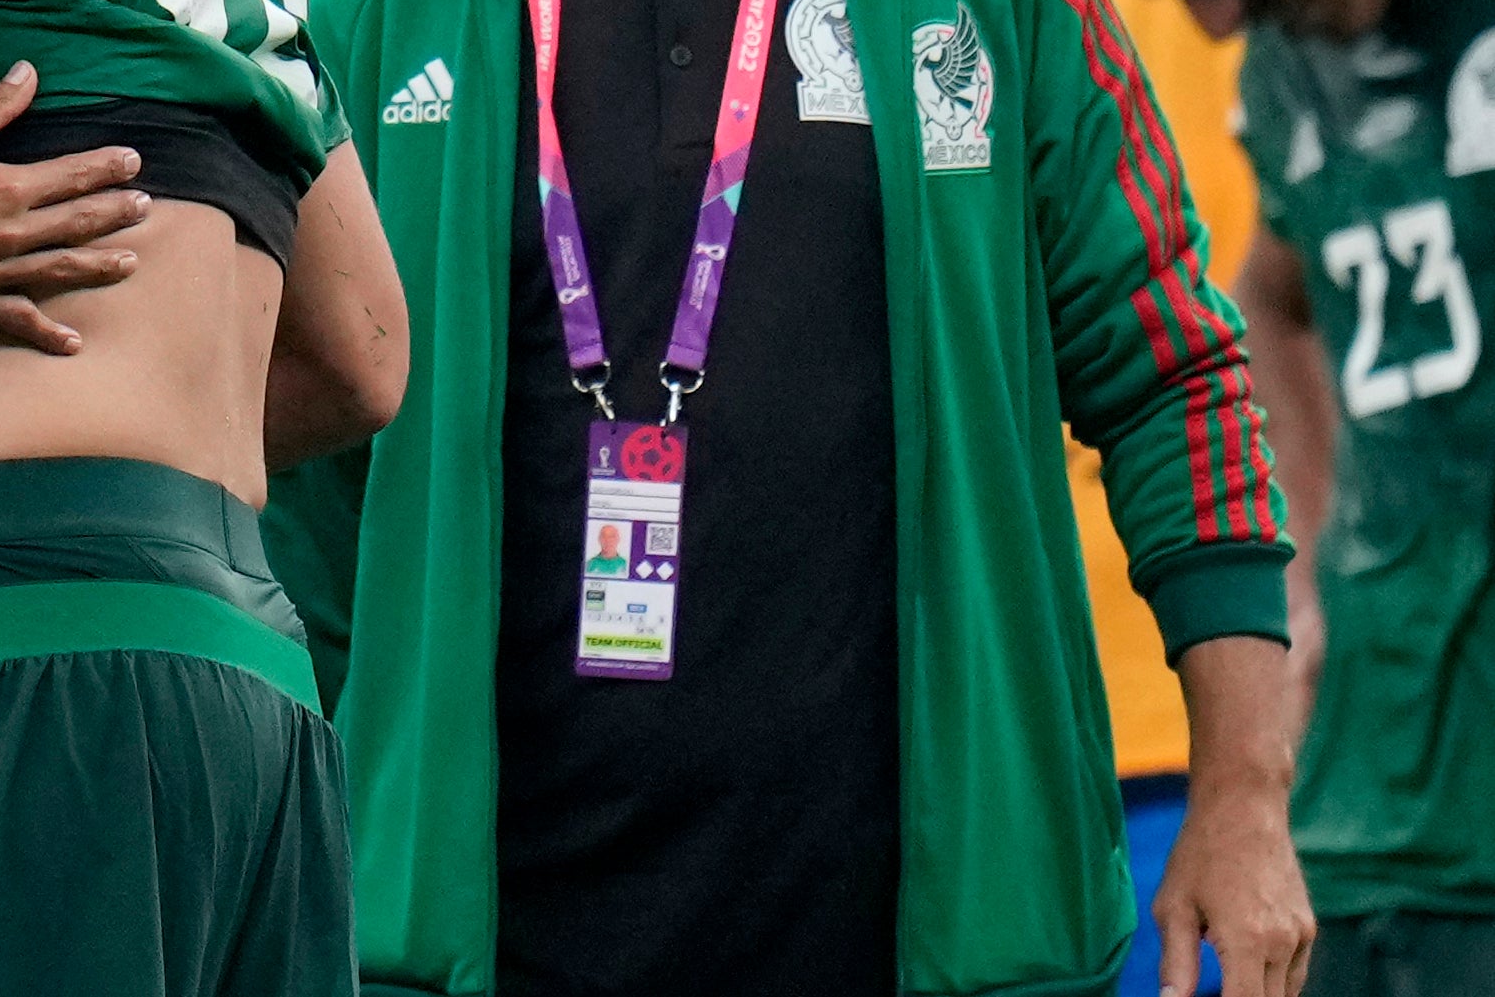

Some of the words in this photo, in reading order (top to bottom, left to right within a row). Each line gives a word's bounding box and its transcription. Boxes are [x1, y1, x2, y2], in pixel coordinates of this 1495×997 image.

[807, 89, 863, 114] MÉX
[1324, 201, 1482, 419] 23
[586, 637, 613, 647] TEAM
[615, 639, 662, 650] OFFICIAL
